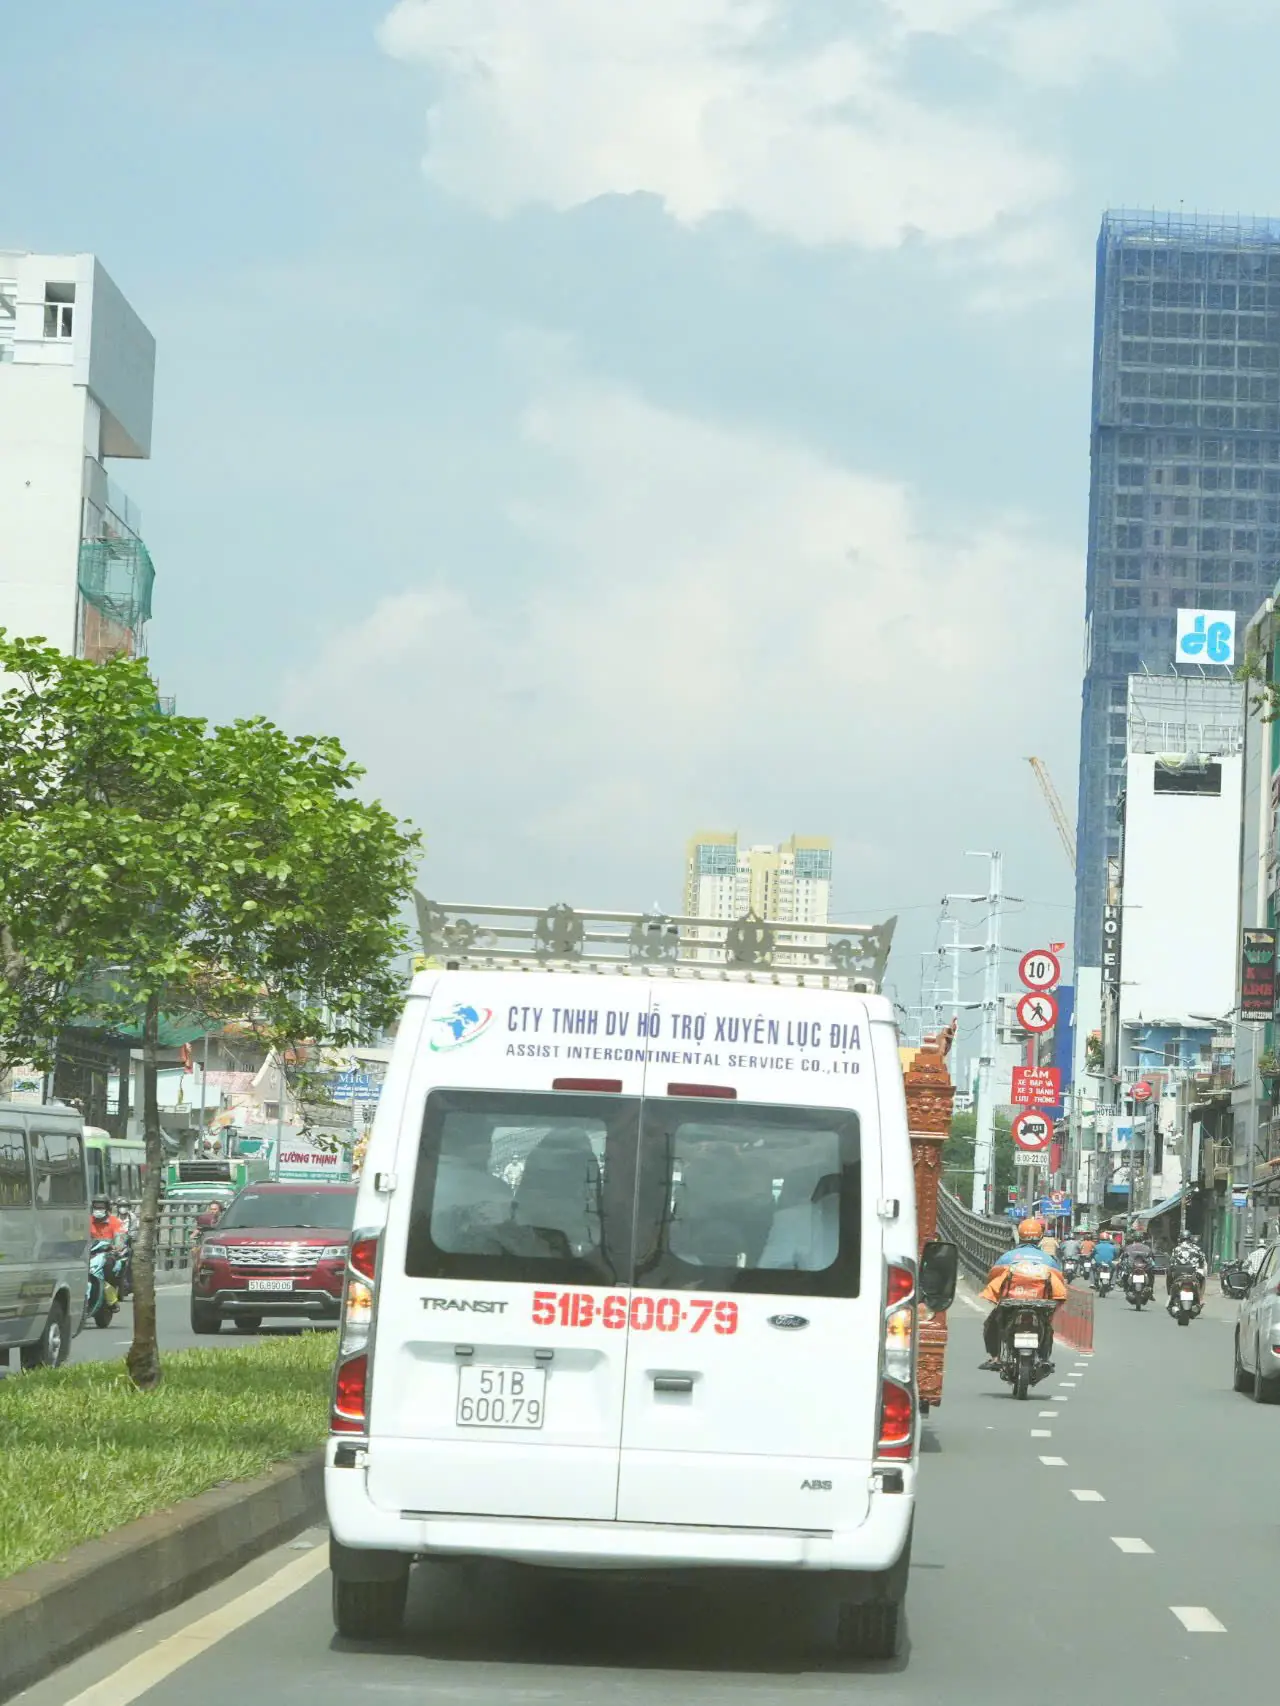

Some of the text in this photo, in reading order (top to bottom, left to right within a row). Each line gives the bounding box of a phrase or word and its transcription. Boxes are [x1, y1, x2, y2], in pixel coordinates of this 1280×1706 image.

[1104, 906, 1117, 981] HOTEL
[508, 1002, 861, 1054] CTY TNHH DV HỖ TRỢ XUYÊN LỤC ĐỊA
[505, 1043, 560, 1058] ASSIST
[567, 1046, 721, 1066] INTERCONTINENTAL
[728, 1054, 794, 1071] SERVICE
[1023, 1066, 1049, 1078] CẤM
[311, 1153, 337, 1167] THỊNH
[419, 1297, 508, 1315] TRANSIT
[479, 1370, 525, 1396] 51B
[460, 1397, 541, 1424] 600.79
[800, 1479, 833, 1491] ABS
